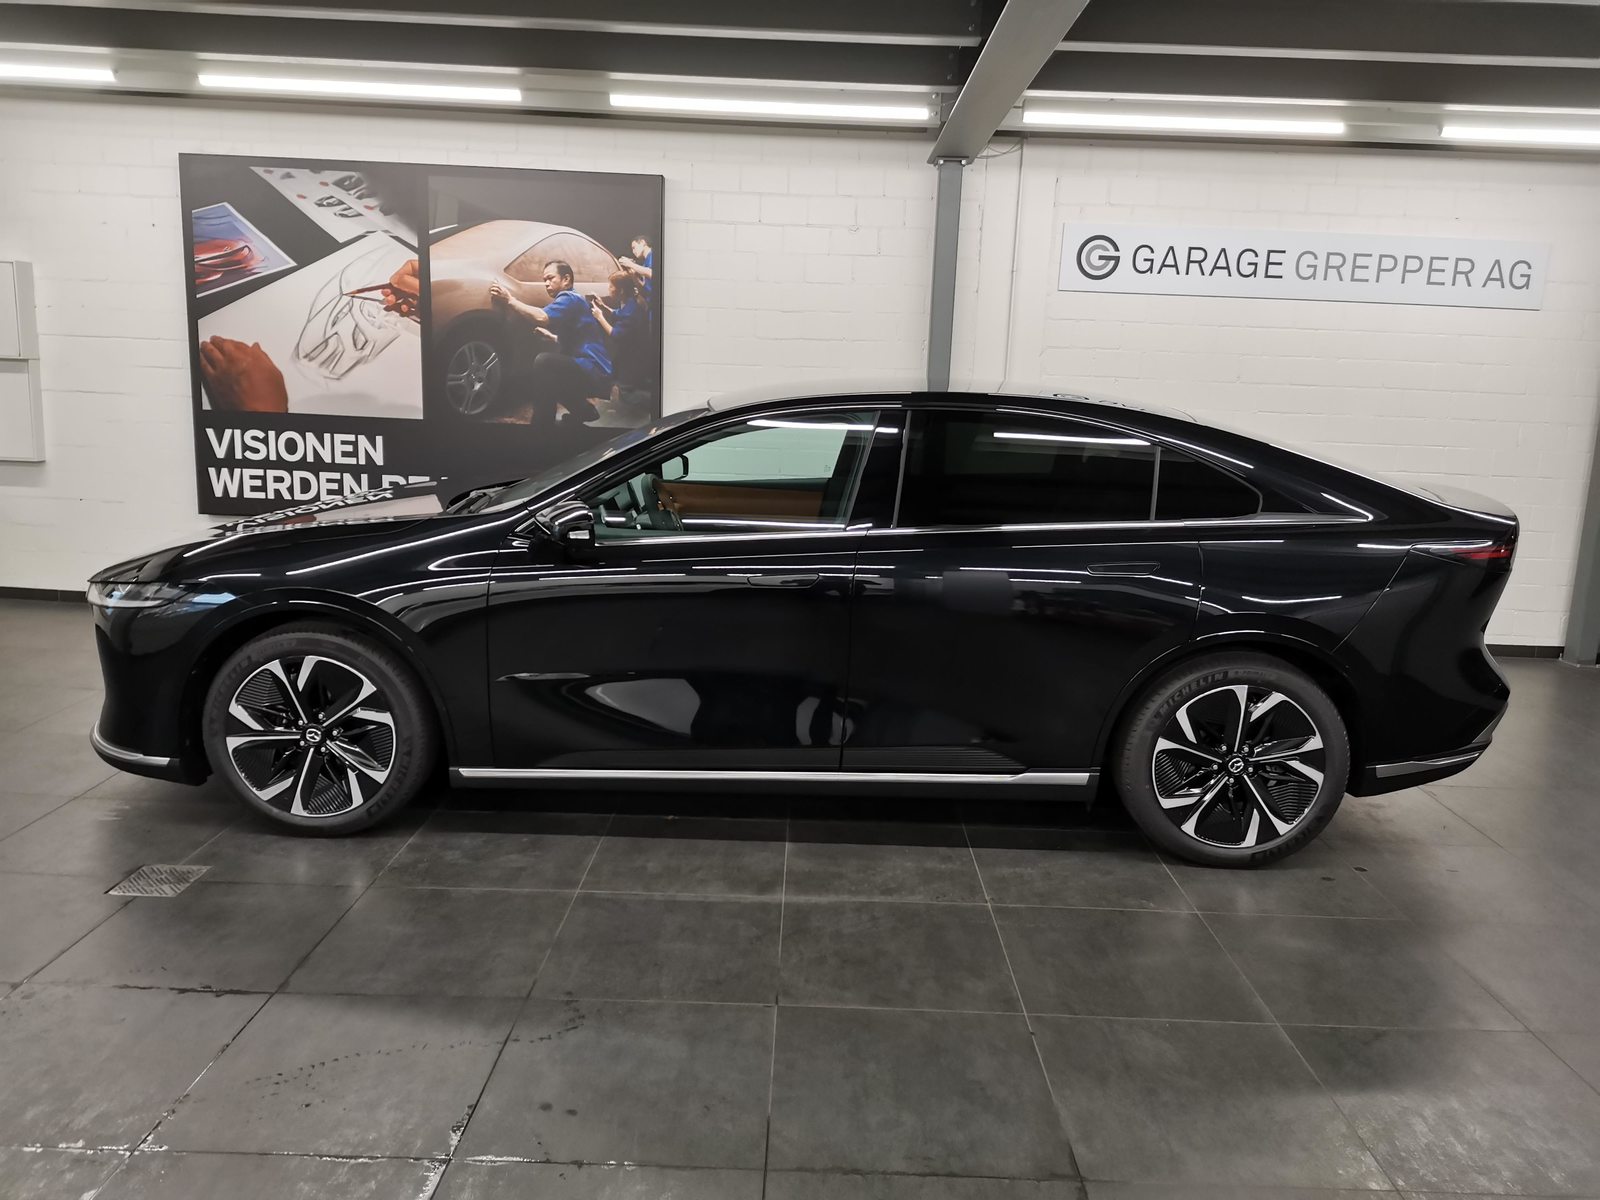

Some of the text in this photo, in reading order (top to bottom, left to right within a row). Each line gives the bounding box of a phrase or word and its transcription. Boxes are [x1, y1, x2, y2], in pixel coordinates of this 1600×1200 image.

[1131, 243, 1533, 291] GARAGE GREPPER AG
[205, 427, 384, 466] VISIONEN
[207, 467, 369, 502] WERDEN
[1159, 671, 1225, 716] MICHELIN
